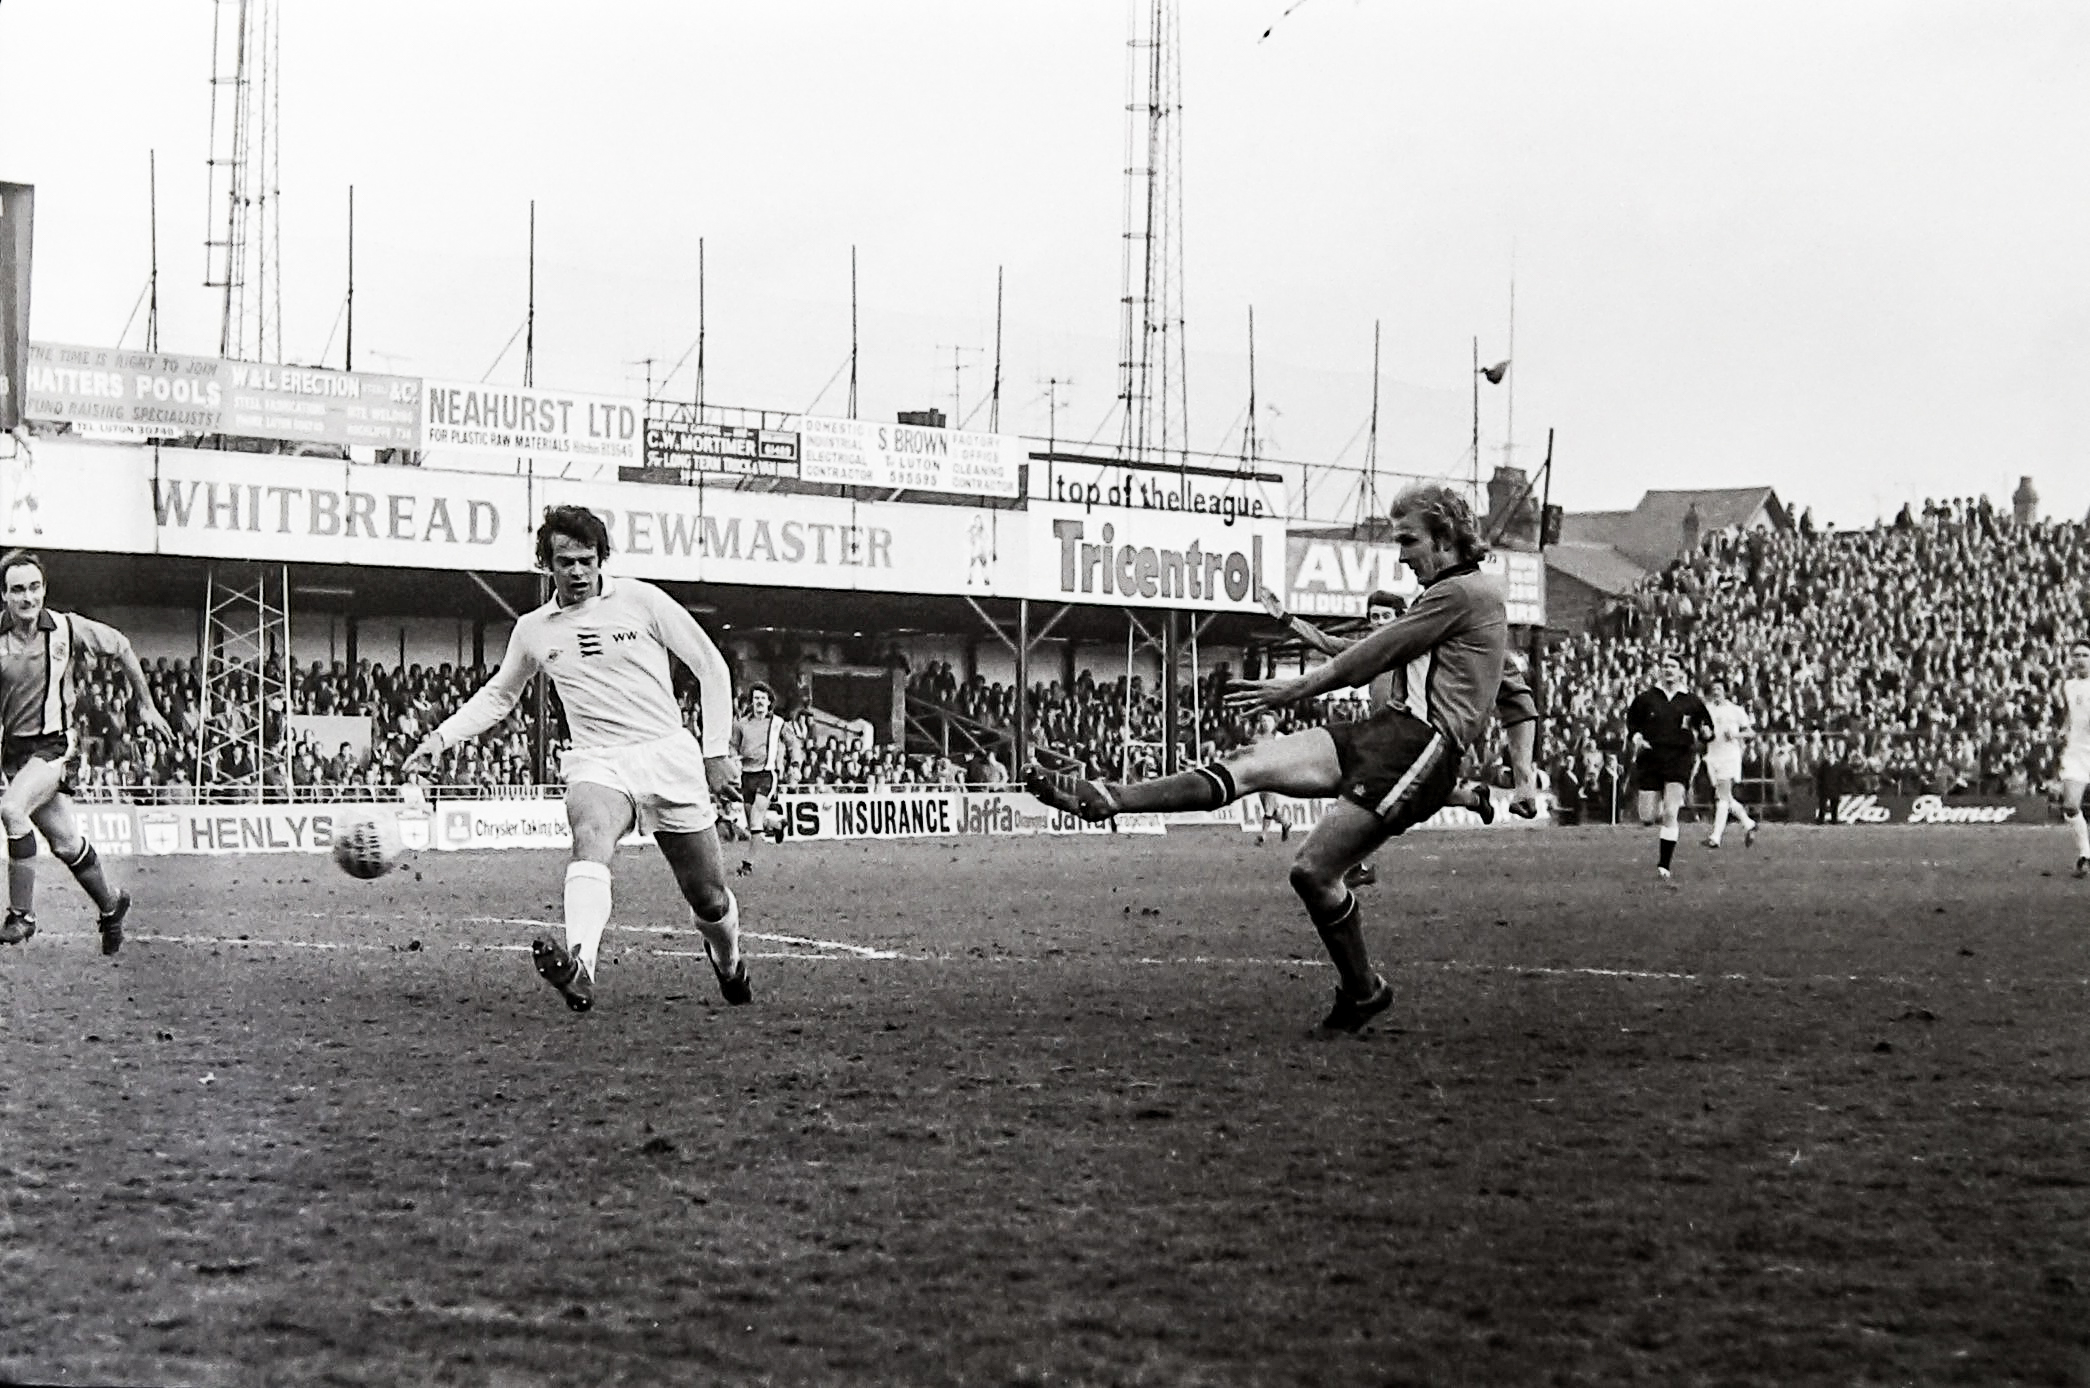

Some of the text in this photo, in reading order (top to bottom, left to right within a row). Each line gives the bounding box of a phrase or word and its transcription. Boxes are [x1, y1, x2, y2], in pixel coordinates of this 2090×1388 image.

[60, 349, 88, 365] TIME
[97, 352, 107, 367] IS
[115, 355, 156, 371] RIGHT
[162, 358, 179, 372] TO
[186, 360, 217, 376] JOIN
[27, 365, 124, 399] HATTERS
[136, 375, 222, 408] POOLS
[281, 371, 361, 399] ERECTION
[28, 400, 63, 415] FUND
[69, 402, 124, 419] RAISING
[133, 406, 222, 429] SPECIALISTS!
[429, 387, 573, 434] NEAHURST
[588, 402, 635, 440] LTD
[100, 423, 134, 434] LUTON
[429, 427, 448, 443] FOR
[451, 429, 488, 446] PLASTIC
[490, 433, 511, 448] RAW
[514, 434, 570, 453] MATERIALS
[806, 420, 864, 436] DOMESTIC
[952, 433, 1001, 447] FACTORY
[806, 434, 863, 450] INDUSTRIAL
[894, 428, 948, 457] BROWN
[806, 449, 868, 466] ELECTRICAL
[899, 457, 941, 471] LUTON
[961, 449, 999, 464] OFFICE
[806, 465, 873, 482] CONTRACTOR
[952, 463, 1005, 478] CLEANING
[951, 477, 1015, 492] CONTRACTOR
[1057, 474, 1101, 514] top
[1108, 474, 1132, 508] of
[149, 478, 895, 569] WHITBREAD REWMASTER
[1053, 519, 1263, 603] Tricentrol
[1290, 592, 1367, 616] INDUST
[835, 799, 951, 836] INSURANCE
[957, 796, 1013, 834] Jaffa
[1907, 794, 2016, 824] Romeo
[92, 813, 131, 841] LTD
[190, 815, 334, 850] HENLYS
[475, 818, 518, 839] Chrysler
[520, 818, 552, 838] Taking
